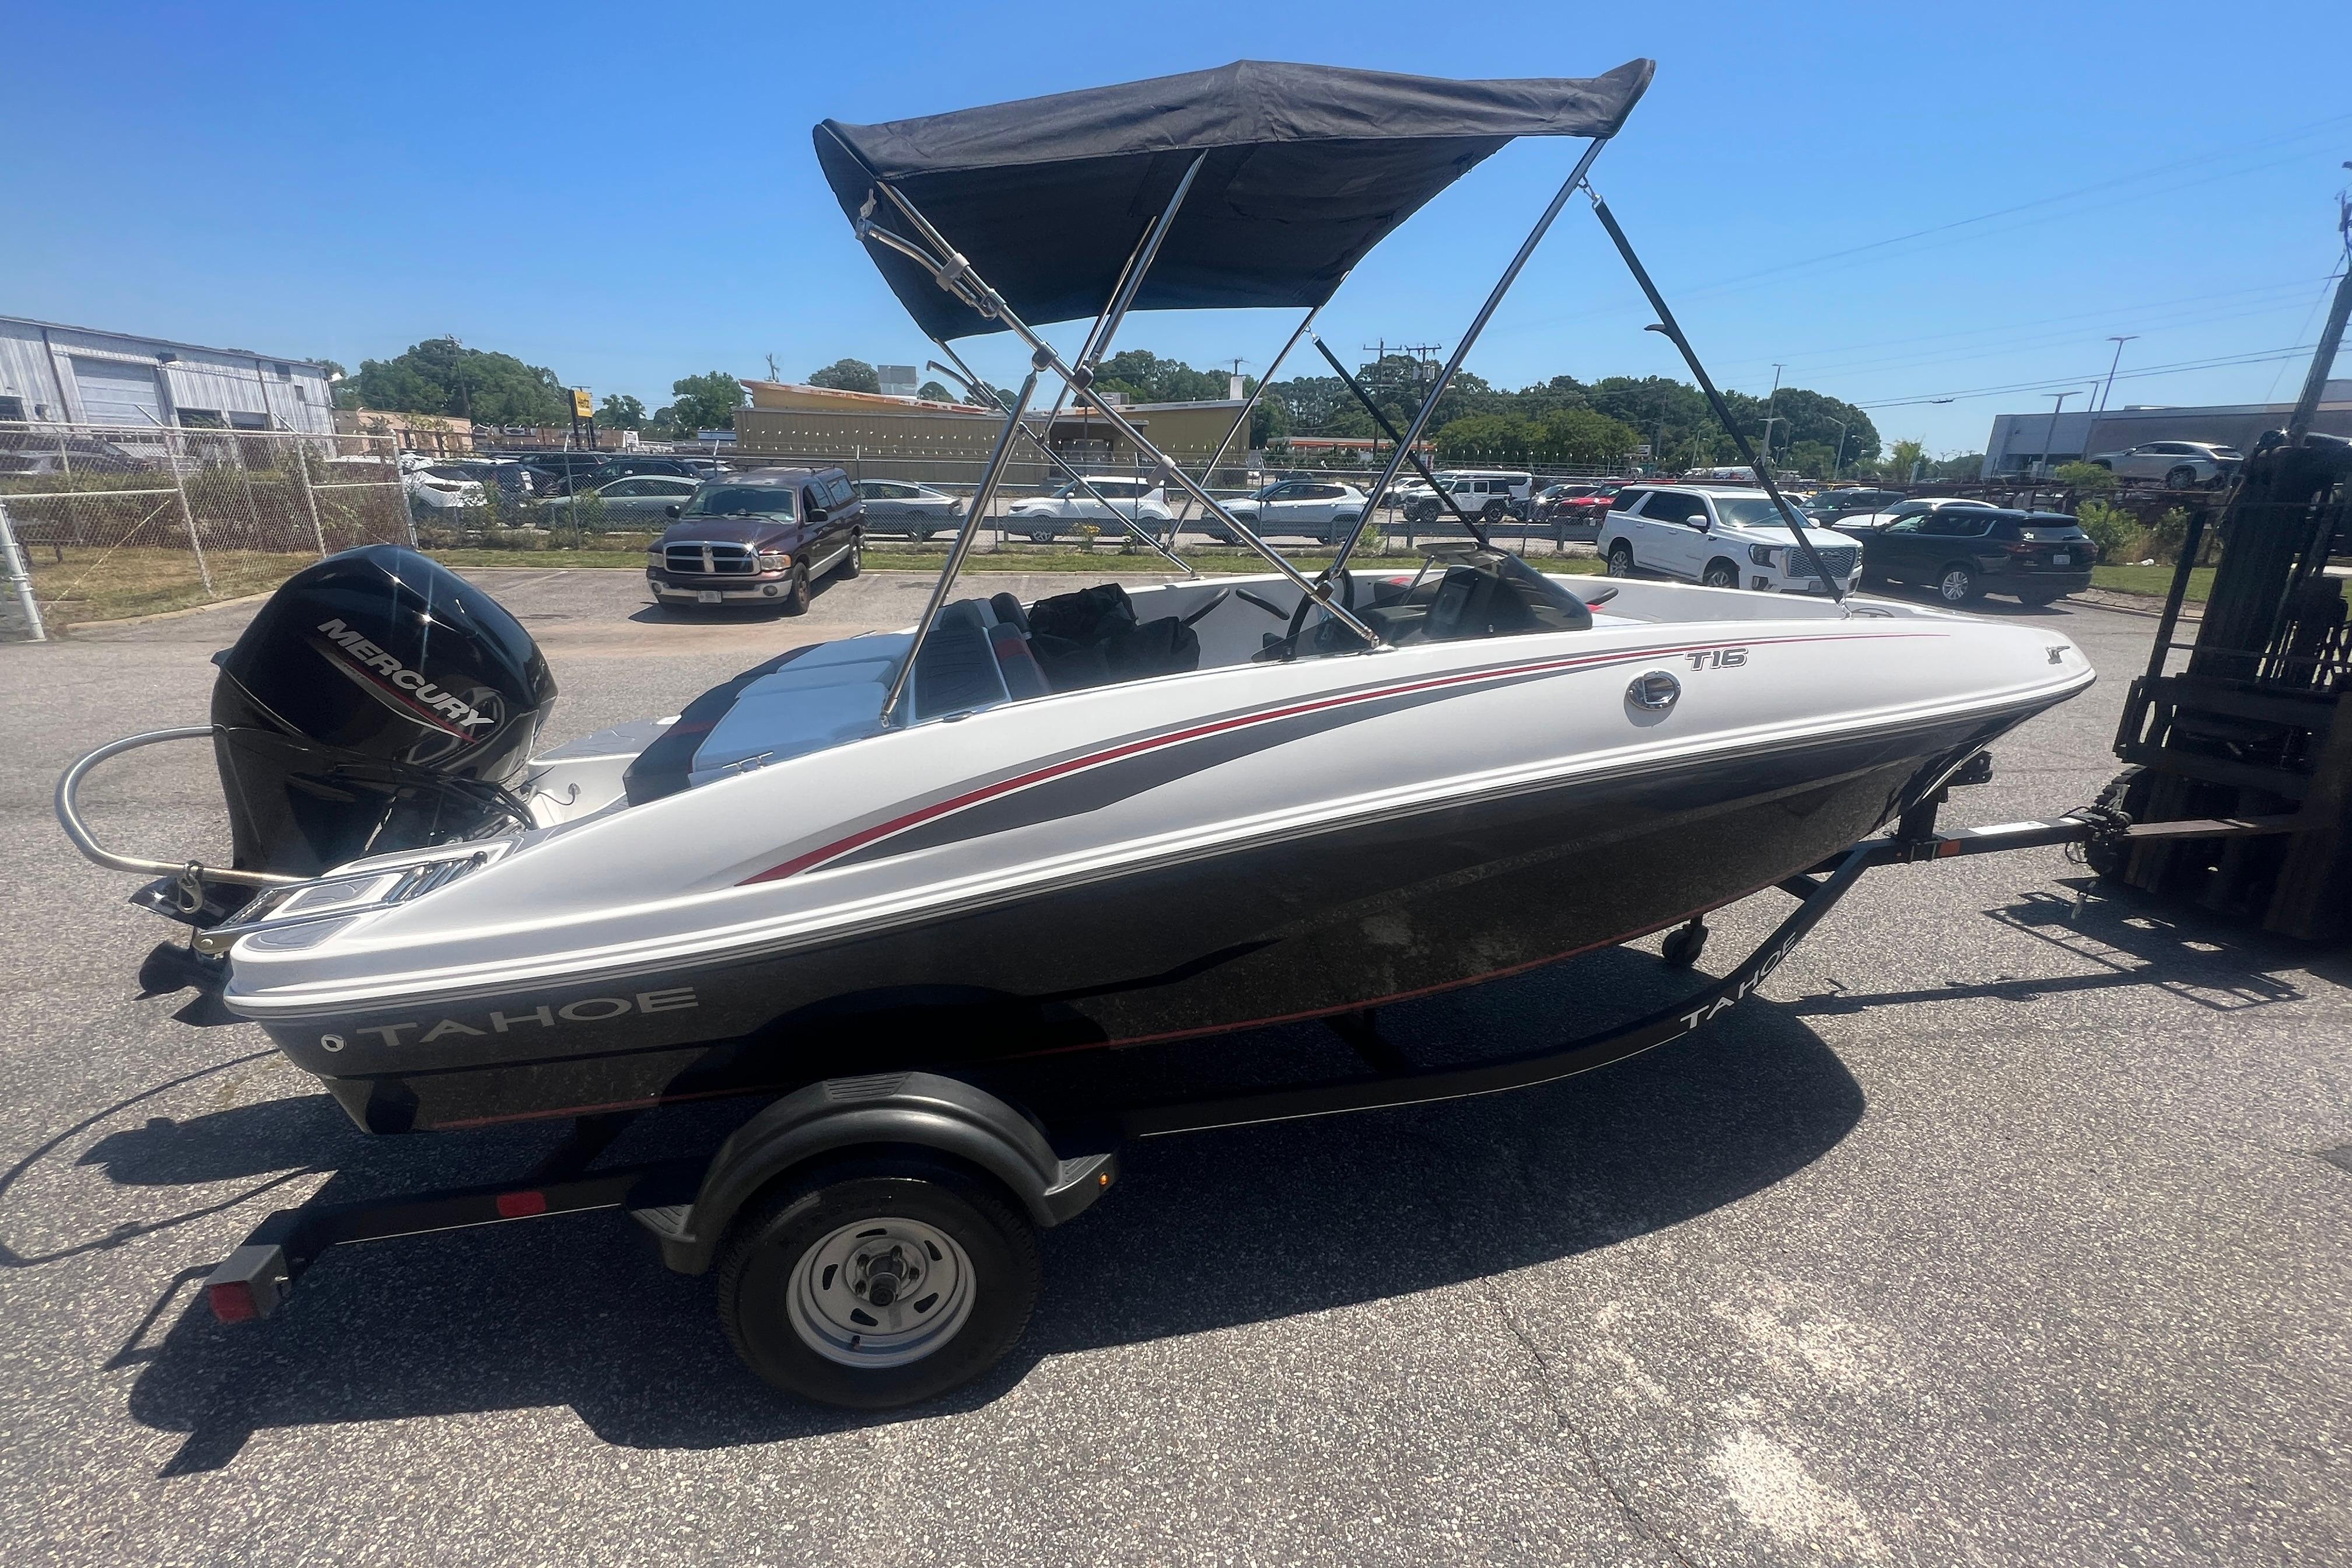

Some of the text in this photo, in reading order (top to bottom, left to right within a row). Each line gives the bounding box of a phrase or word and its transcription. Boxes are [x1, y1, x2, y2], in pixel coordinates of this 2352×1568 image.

[317, 618, 495, 726] MERCURY
[1685, 648, 1748, 671] T16
[356, 987, 699, 1046] TAHOE
[1680, 932, 1797, 1029] TAHOE
